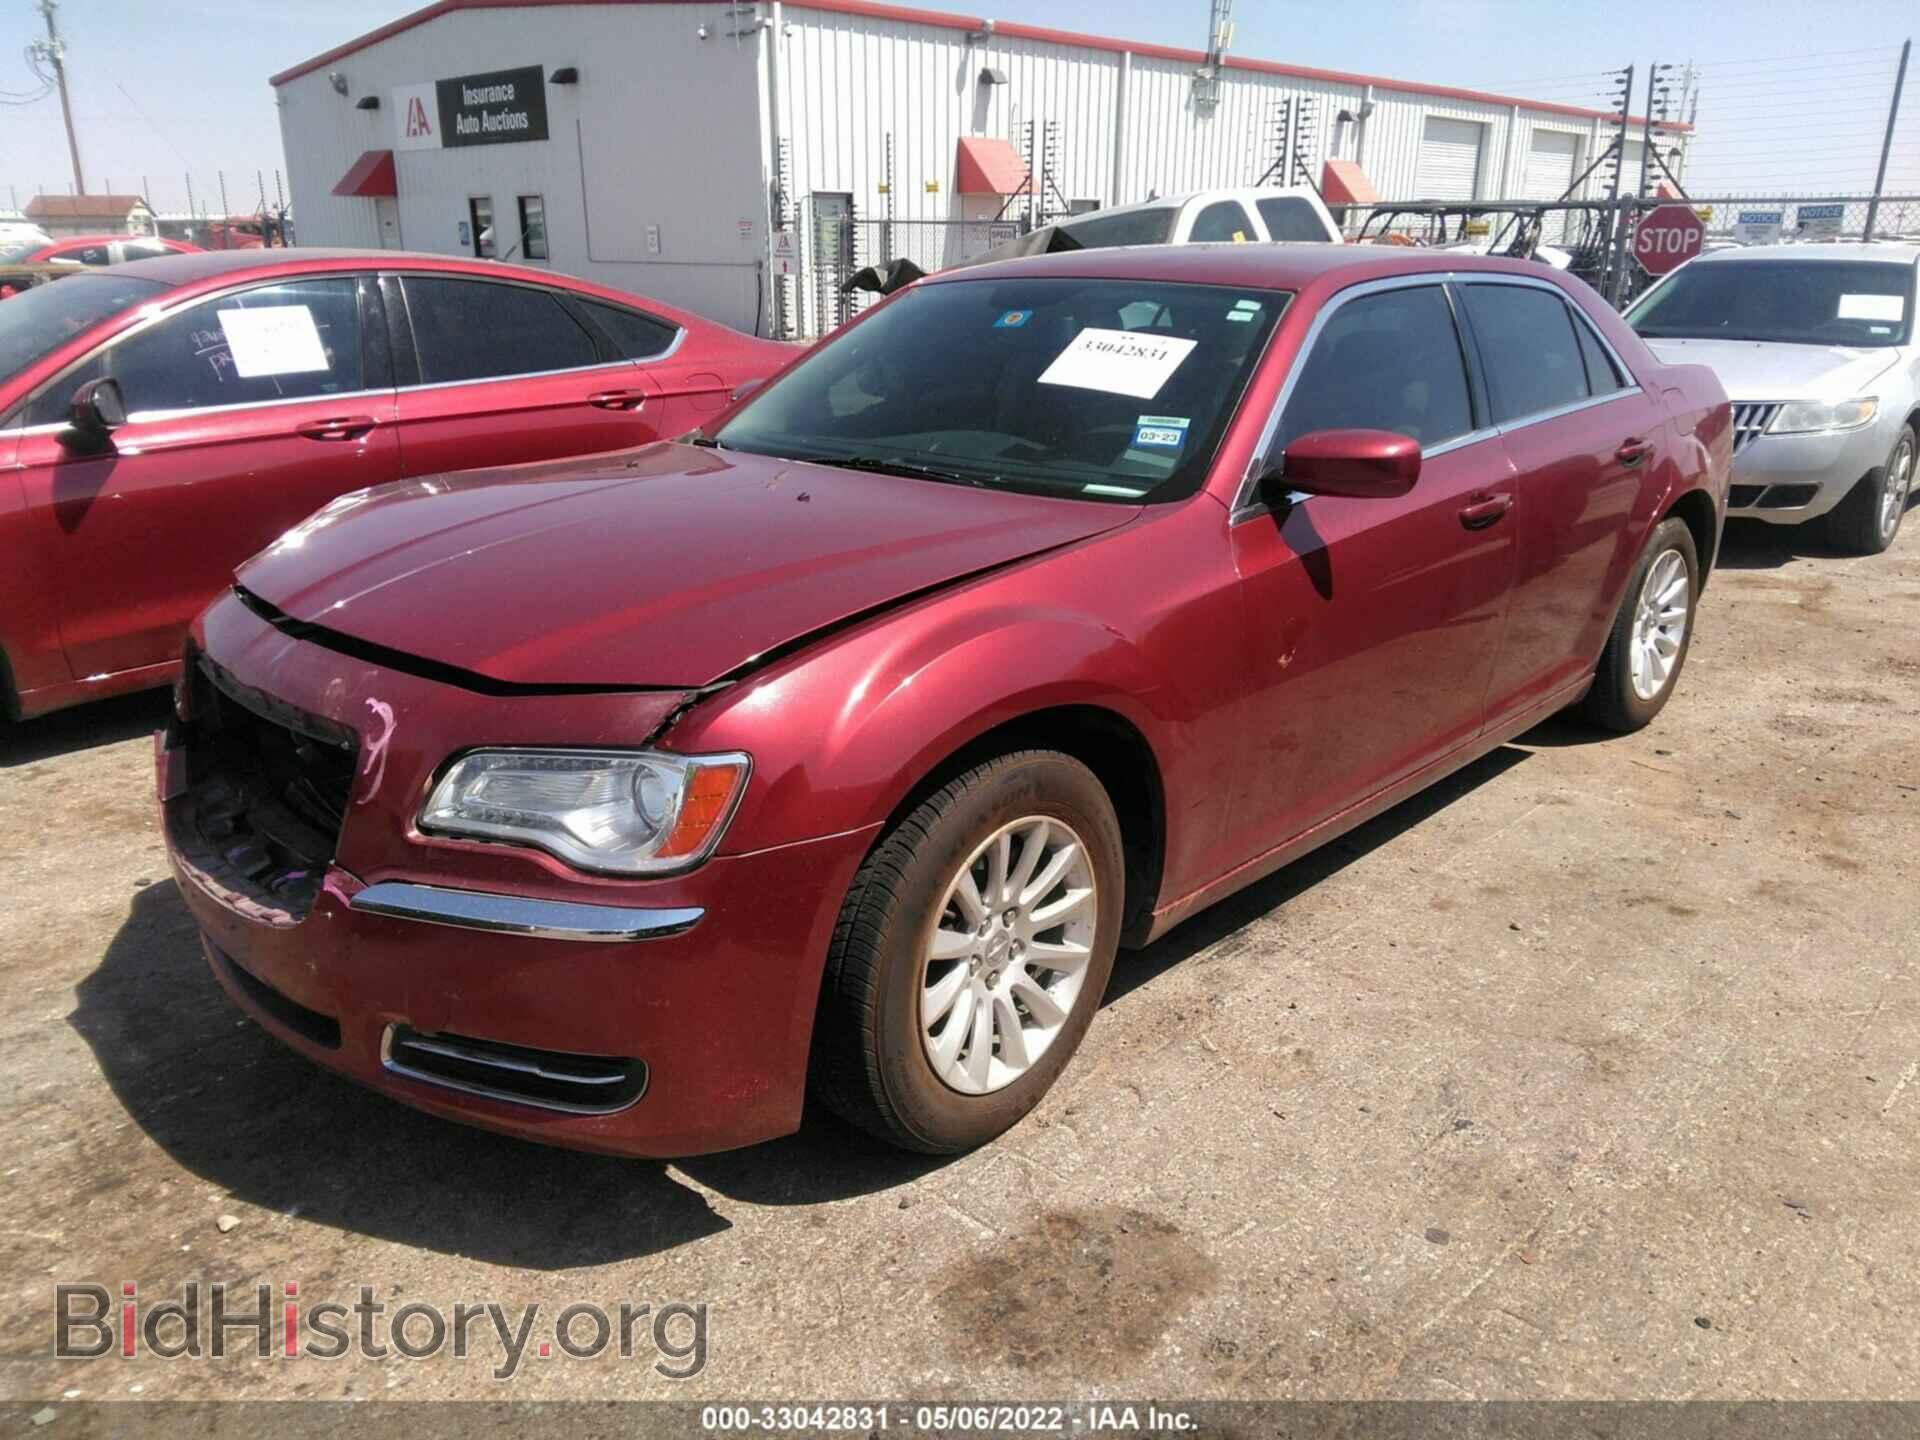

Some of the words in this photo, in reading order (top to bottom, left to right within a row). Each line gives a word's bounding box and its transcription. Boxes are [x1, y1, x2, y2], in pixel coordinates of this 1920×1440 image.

[462, 83, 515, 106] Insurance
[456, 112, 480, 135] Auto
[481, 107, 529, 132] Auctions
[1742, 213, 1777, 224] NOTICE
[1800, 206, 1841, 218] NOTICE
[1638, 227, 1700, 254] STOP
[1078, 339, 1169, 361] 33042831
[1140, 431, 1178, 443] 03-23
